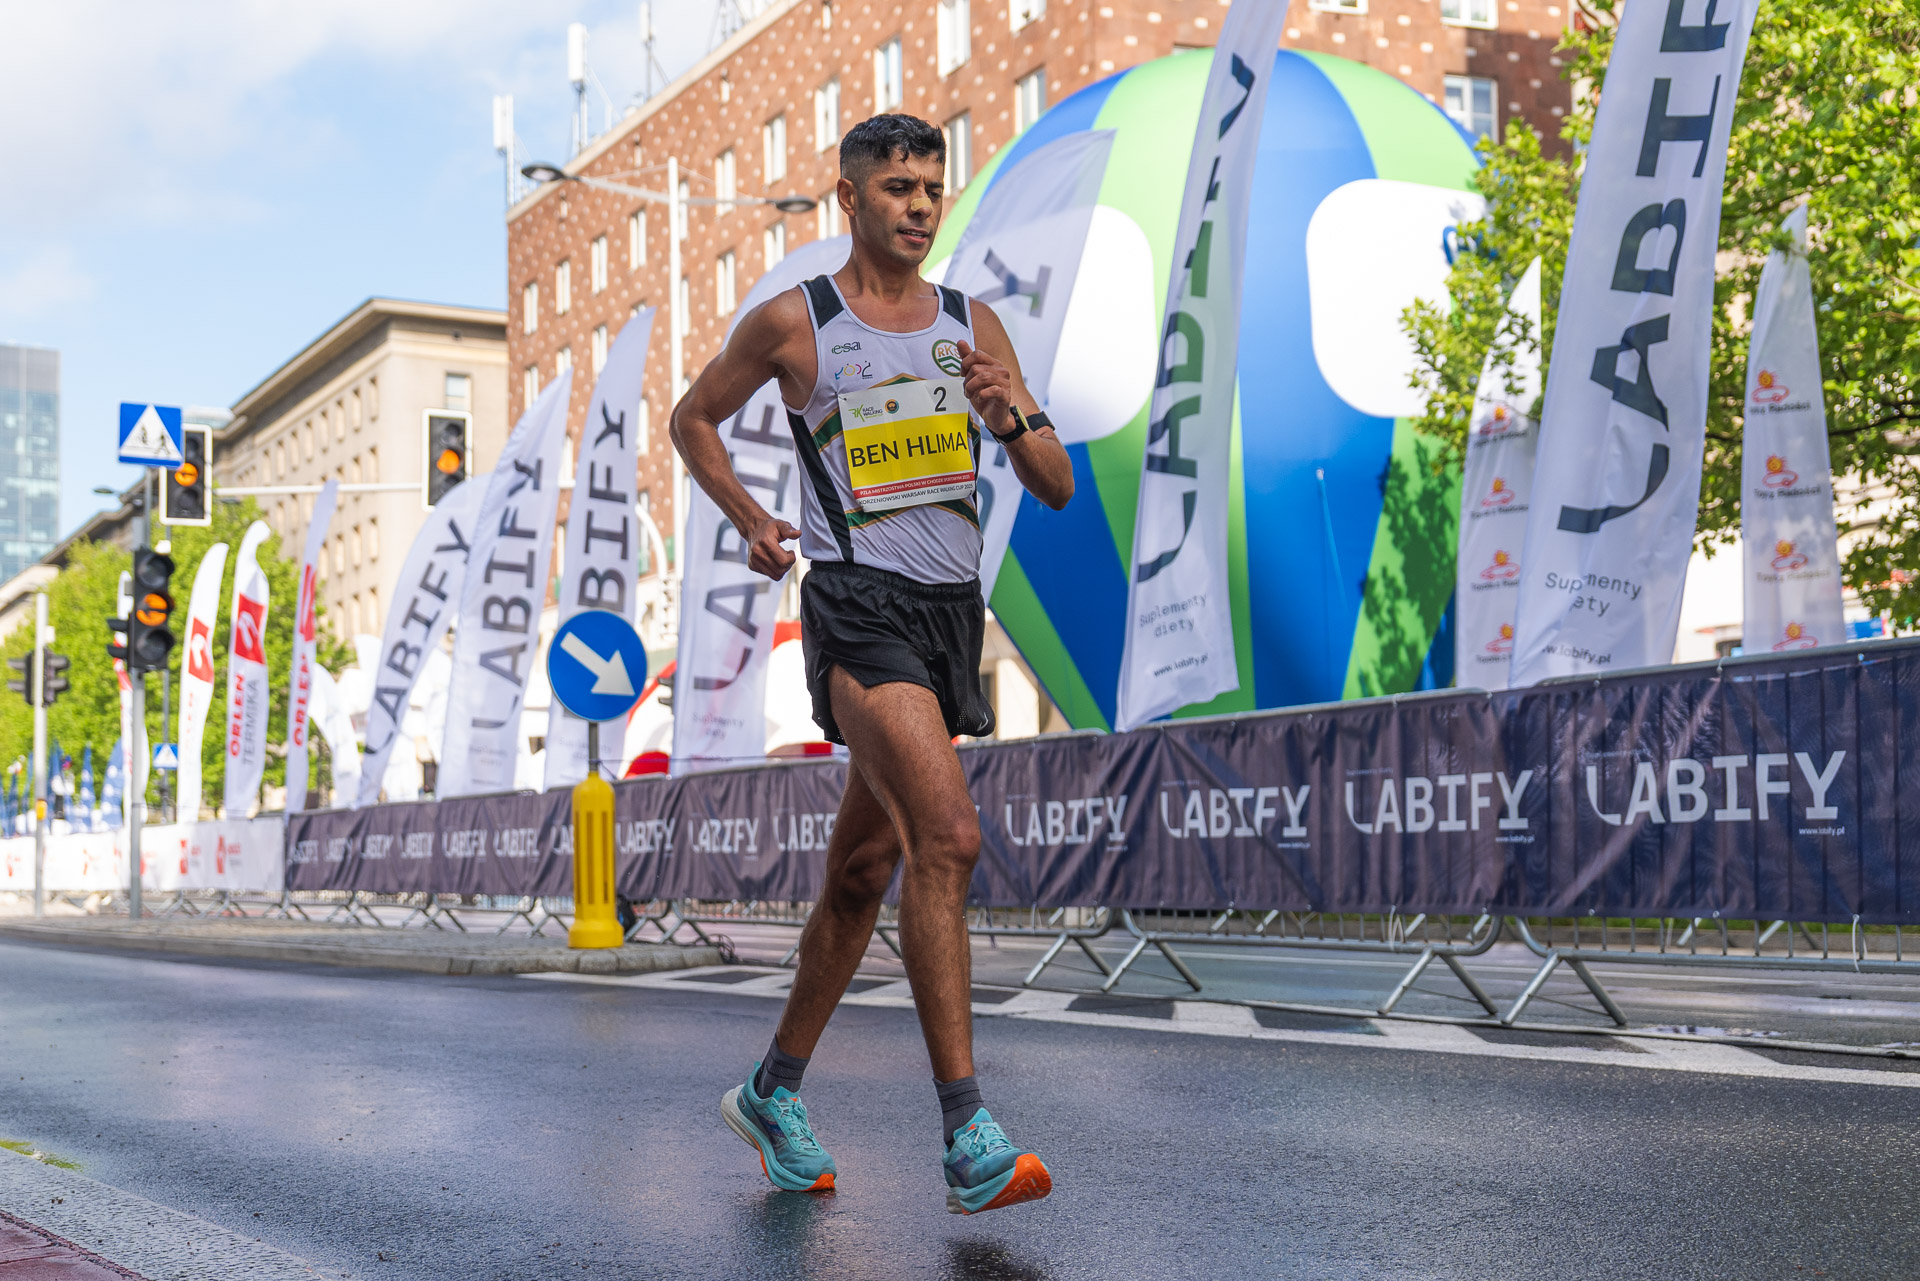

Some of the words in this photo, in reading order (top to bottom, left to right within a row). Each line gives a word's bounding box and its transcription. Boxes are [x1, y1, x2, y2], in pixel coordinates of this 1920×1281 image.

[1556, 0, 1732, 534] LABIF
[933, 386, 947, 412] 2
[850, 440, 900, 468] BEN
[906, 431, 968, 459] HLIMA
[577, 399, 630, 613] BIFY
[901, 490, 926, 499] WARSAW
[472, 456, 543, 730] LABIFY
[1140, 594, 1206, 627] Suplementy
[364, 518, 471, 755] LABIFY
[1155, 618, 1194, 638] diety
[229, 673, 246, 758] ORLEN
[1160, 784, 1311, 838] LABIFY
[1345, 769, 1534, 834] LABIFY
[1586, 750, 1846, 826] LABIFY
[688, 817, 759, 854] LABIFY
[1005, 794, 1128, 847] LABIFY
